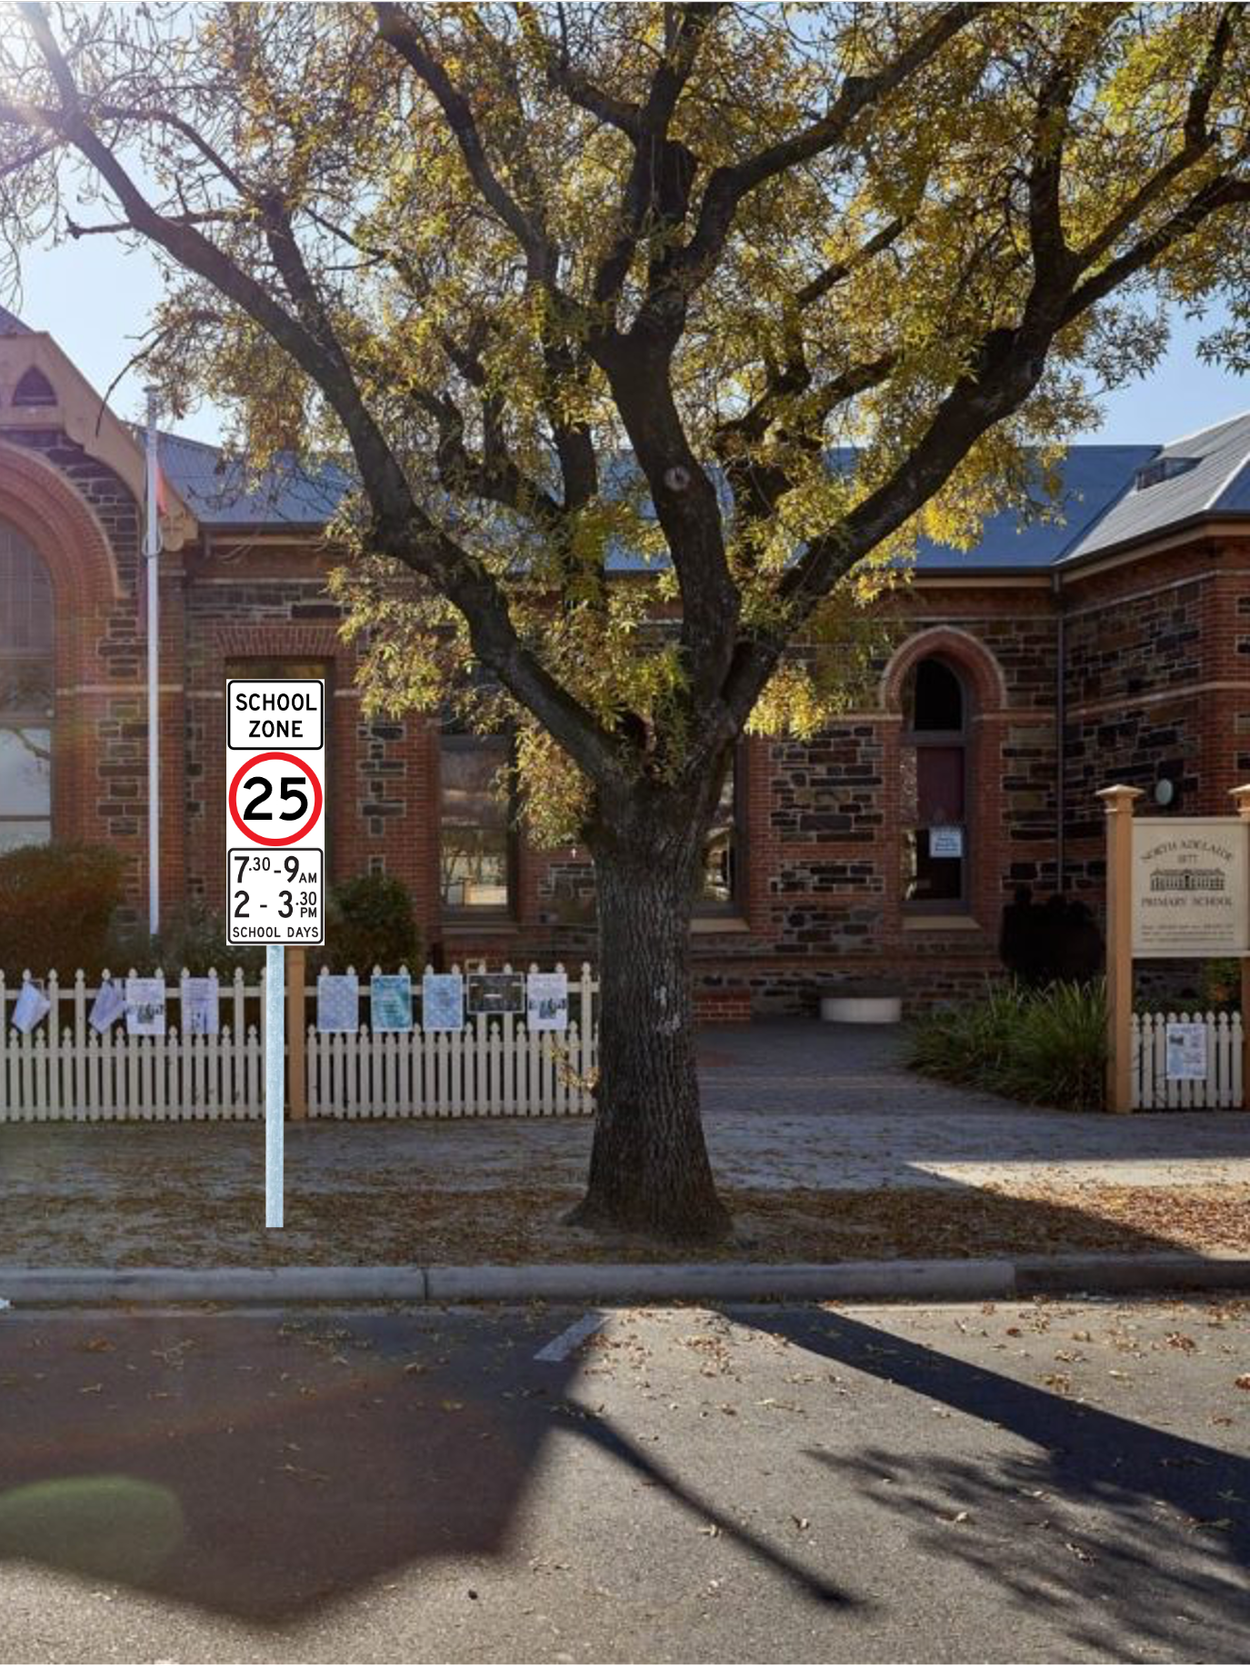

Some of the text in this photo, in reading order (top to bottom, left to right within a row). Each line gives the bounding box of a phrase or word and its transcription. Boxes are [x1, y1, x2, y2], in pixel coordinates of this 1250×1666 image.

[235, 693, 318, 711] SCHOOL
[249, 720, 304, 738] ZONE
[243, 776, 309, 822] 25
[1140, 841, 1177, 862] NORTH
[1141, 896, 1233, 908] PRIMARY SCHOOL
[232, 926, 319, 938] SCHOOL DAYS
